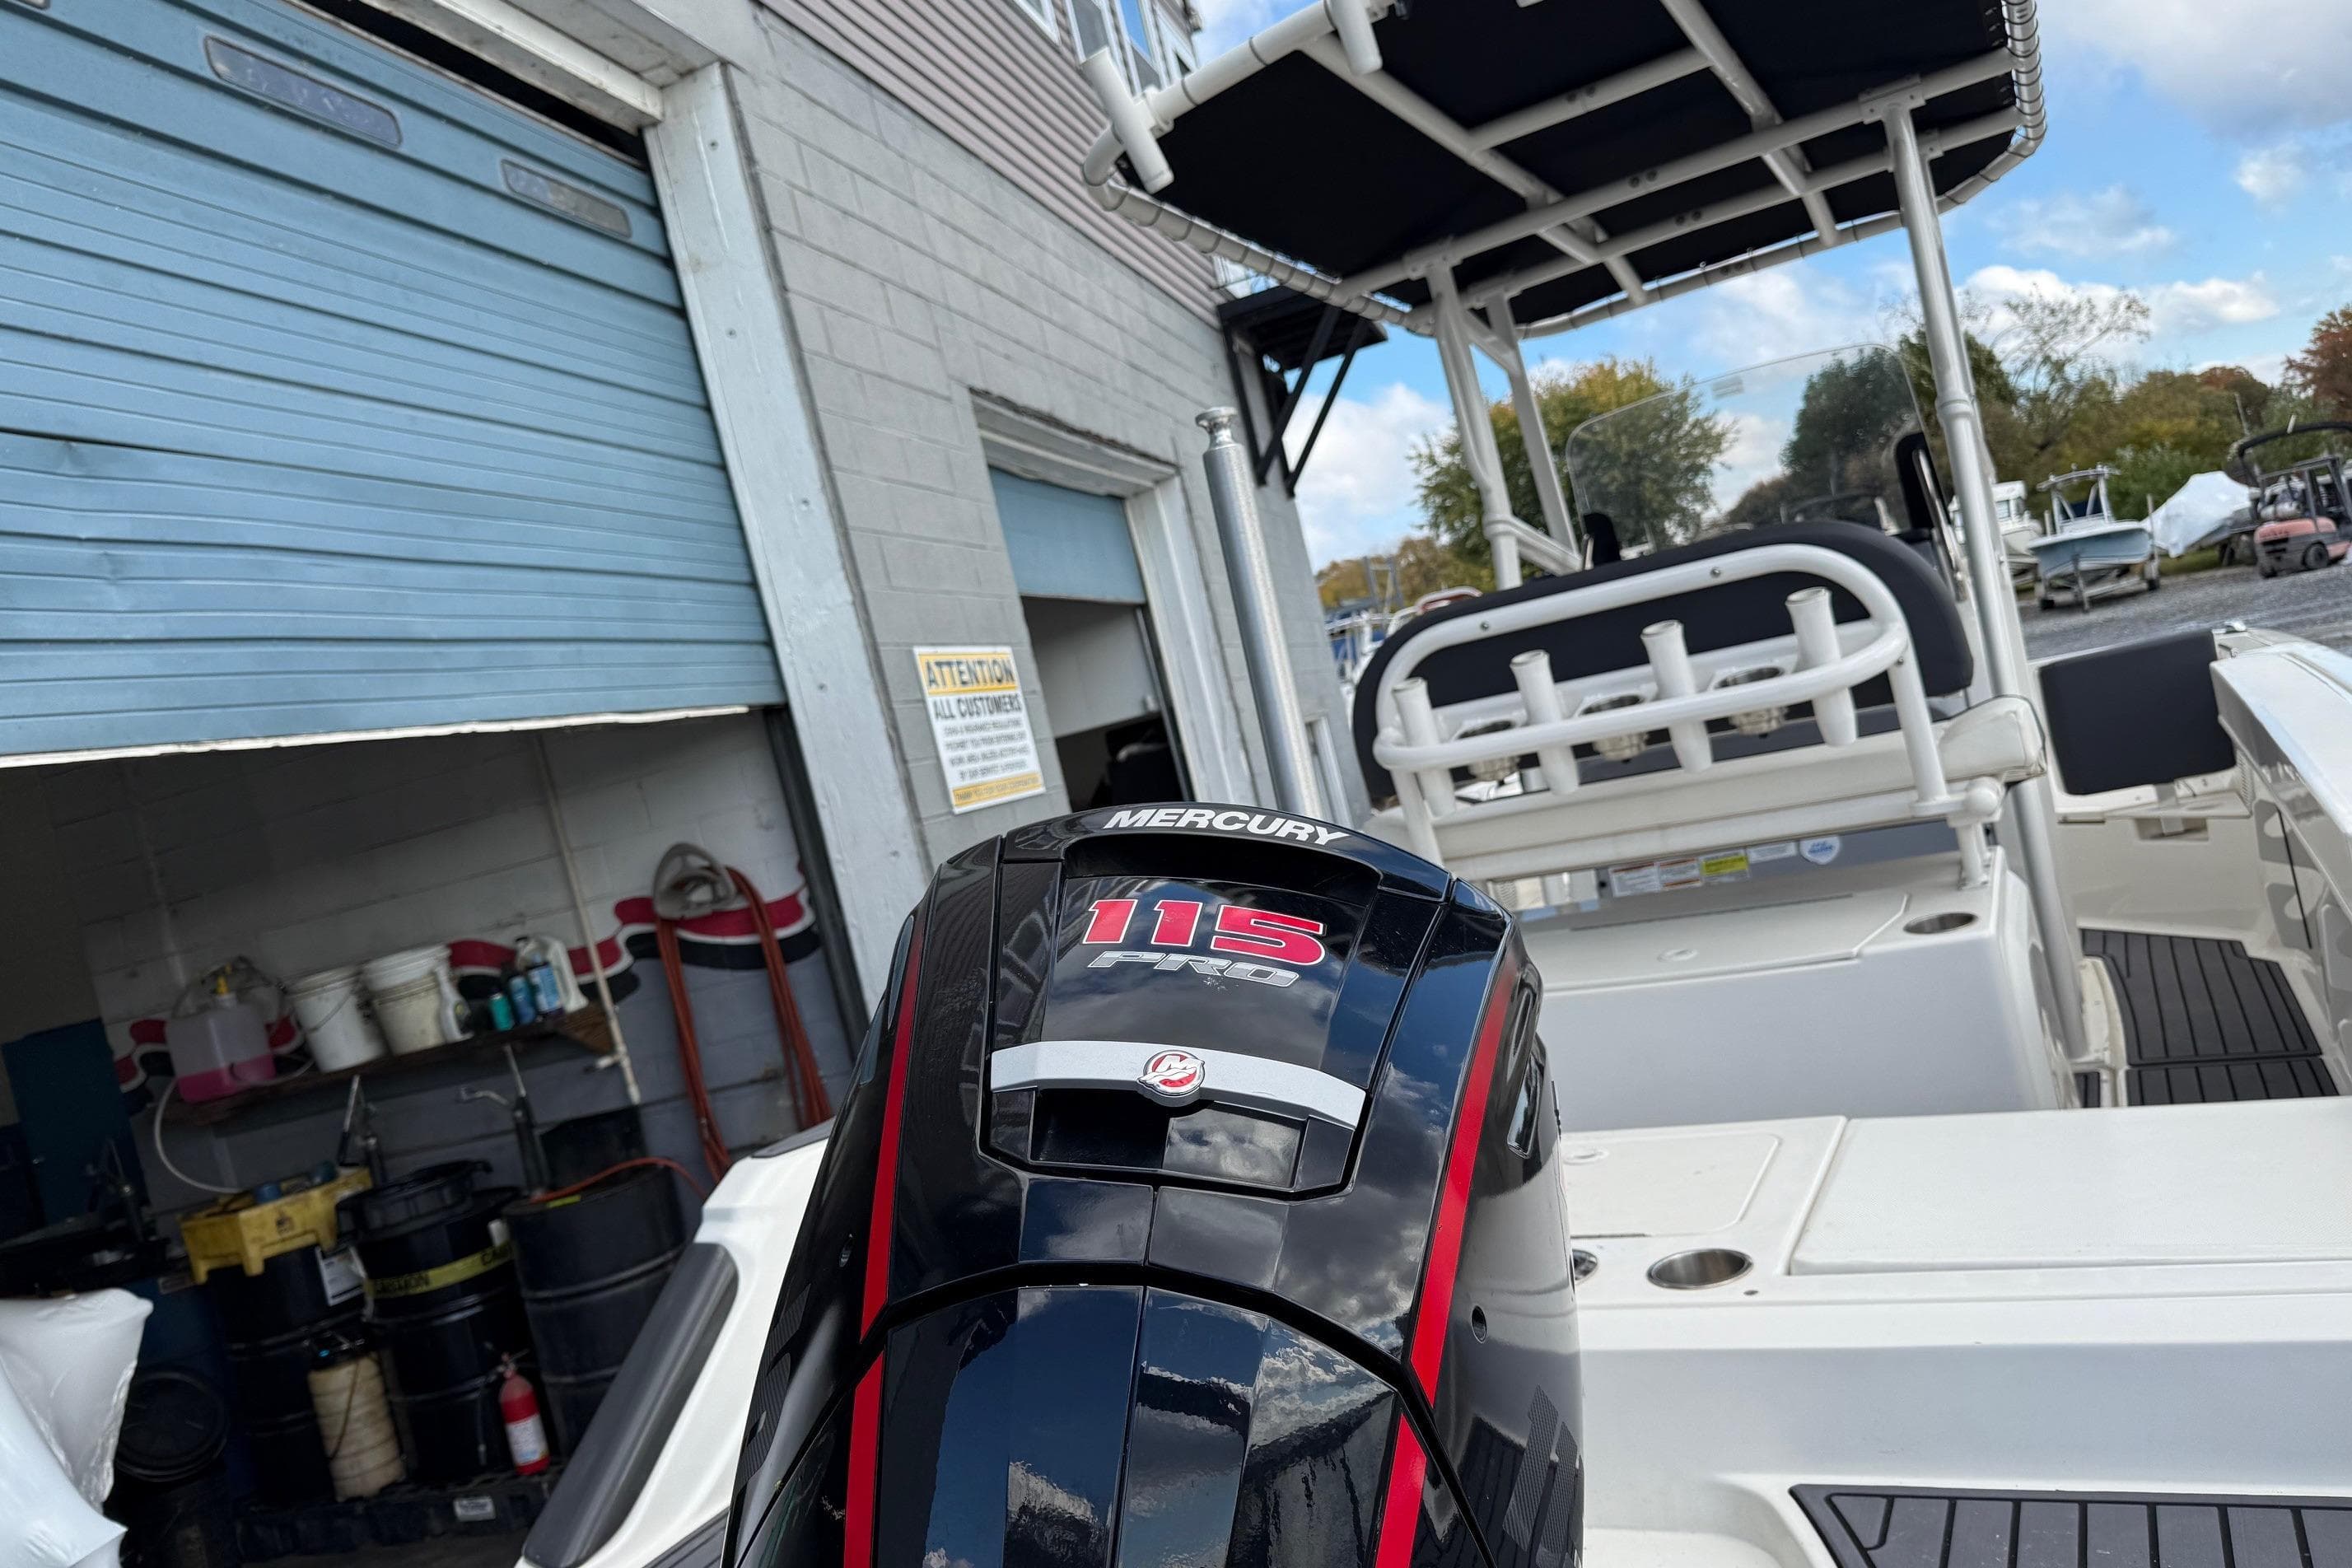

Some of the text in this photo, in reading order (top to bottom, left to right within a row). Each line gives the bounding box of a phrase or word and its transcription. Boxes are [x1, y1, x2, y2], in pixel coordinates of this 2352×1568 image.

[926, 659, 1015, 688] ATTENTION
[933, 693, 1022, 720] ALL CUSTOMERS
[1103, 808, 1349, 845] MERCURY
[1082, 899, 1326, 966] 115
[1087, 950, 1300, 987] PRO
